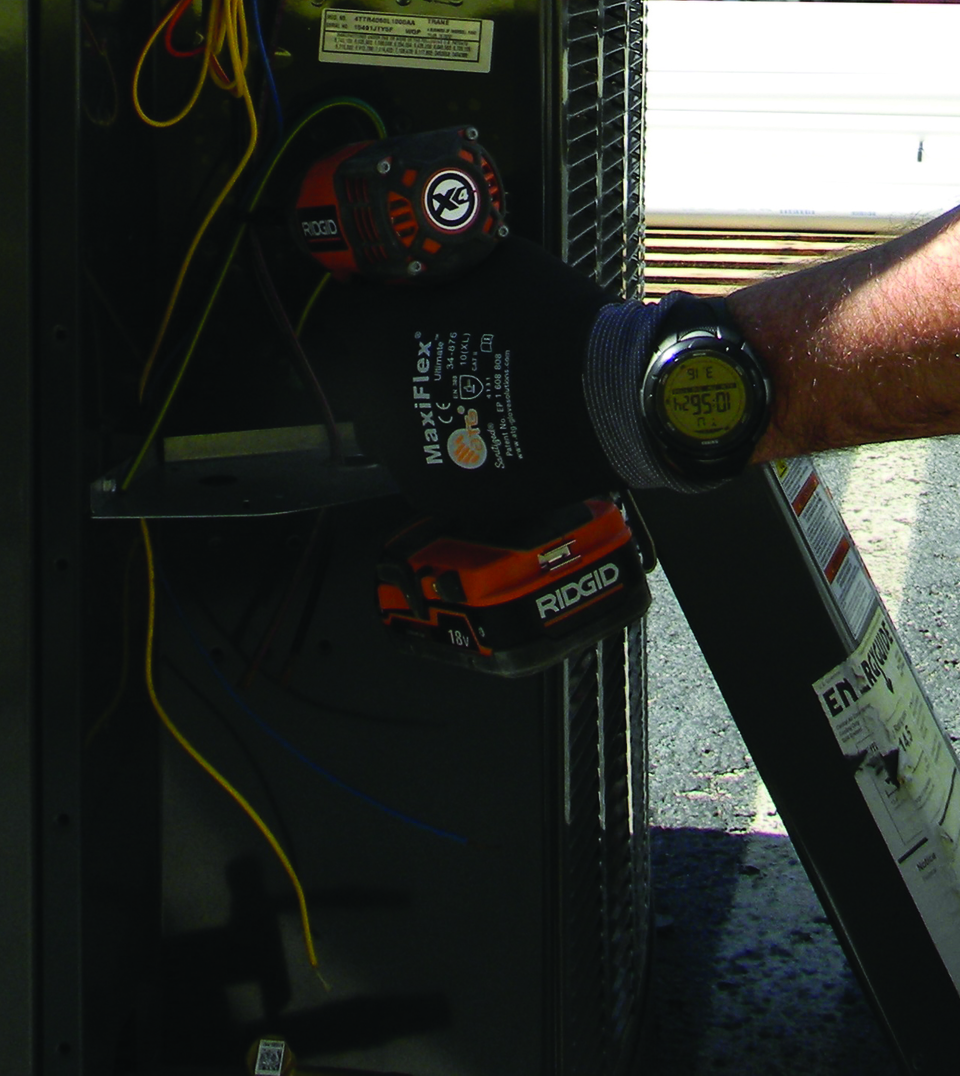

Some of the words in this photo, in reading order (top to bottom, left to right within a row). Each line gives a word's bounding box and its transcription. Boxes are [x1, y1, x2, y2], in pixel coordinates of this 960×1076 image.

[427, 18, 450, 26] TRANE
[431, 187, 470, 217] X4
[301, 219, 338, 237] RIDGID
[446, 331, 458, 370] 34-876
[459, 332, 472, 366] 10(XL)
[494, 353, 502, 370] 808
[494, 373, 502, 390] 608
[496, 401, 504, 413] EP
[501, 435, 513, 457] Patent
[535, 562, 620, 619] RIDGID
[916, 852, 937, 872] Notice
